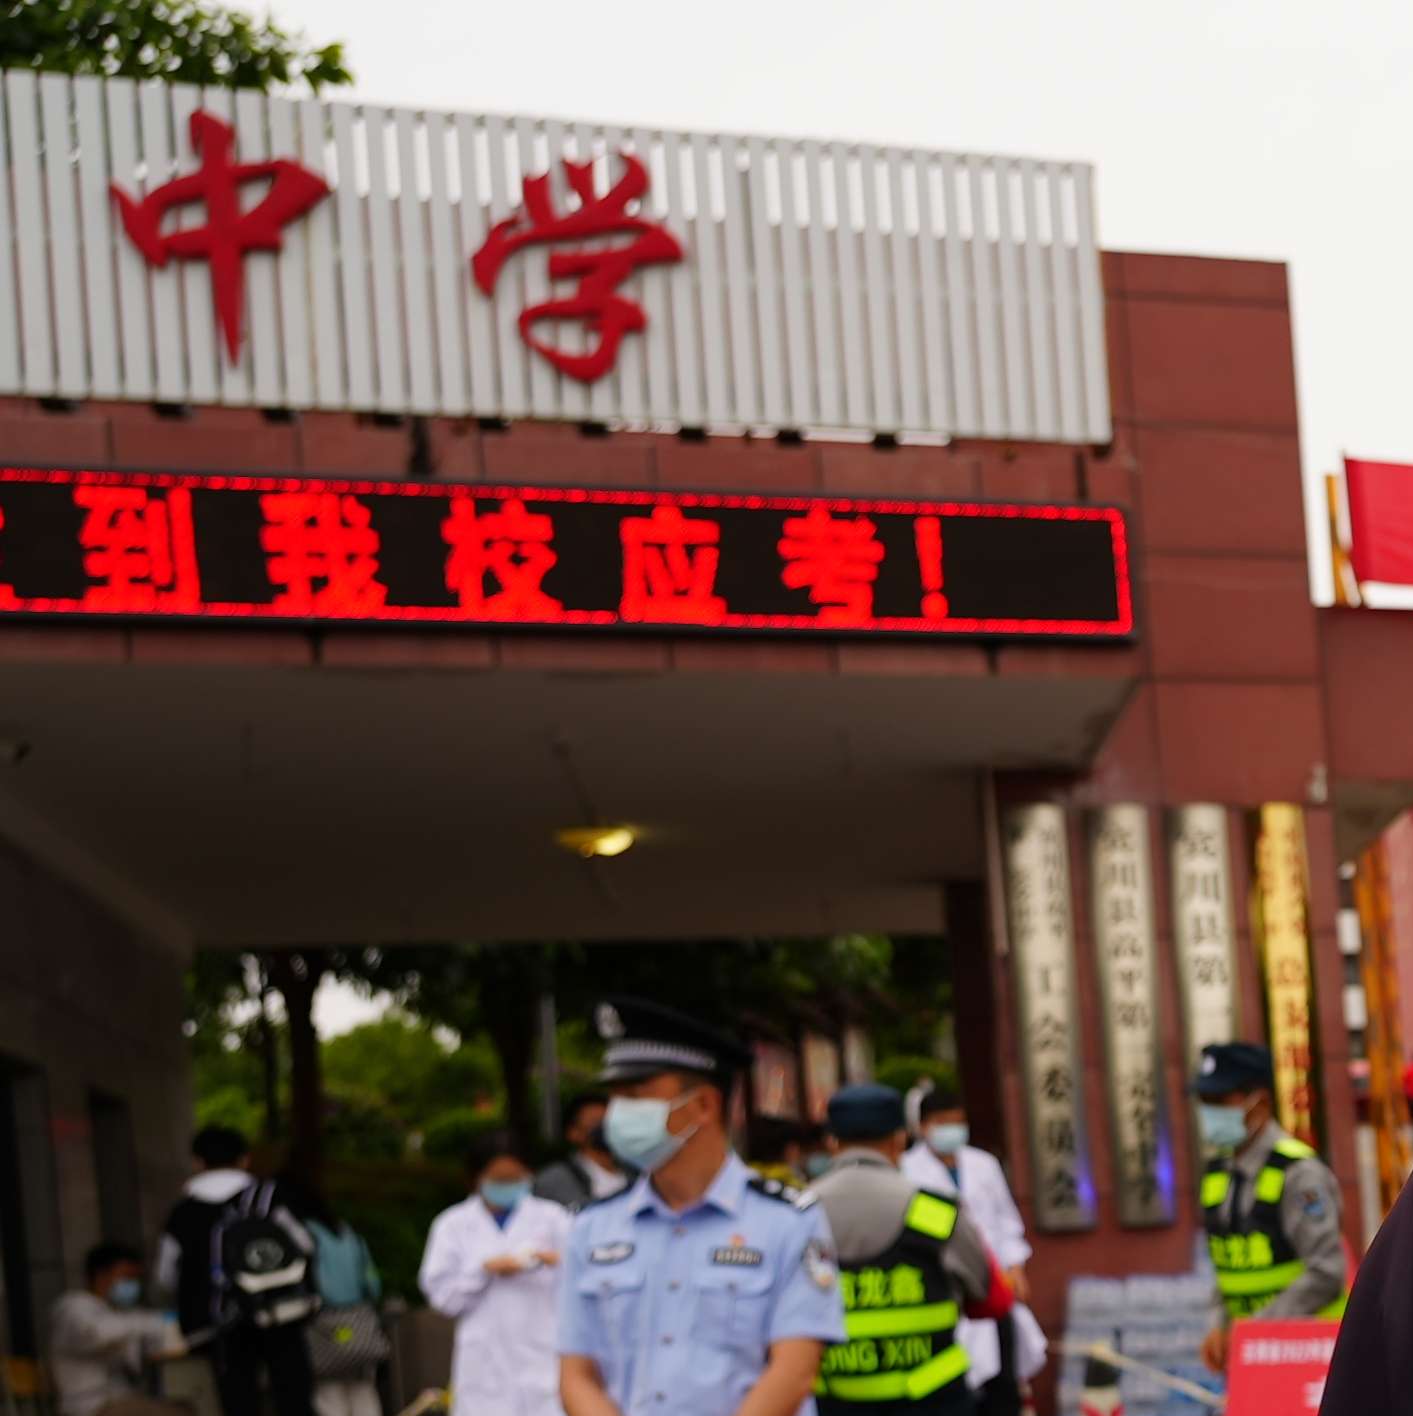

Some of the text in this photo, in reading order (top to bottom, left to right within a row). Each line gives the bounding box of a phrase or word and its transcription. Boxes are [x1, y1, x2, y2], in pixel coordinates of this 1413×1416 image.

[110, 108, 684, 381] 中学
[0, 484, 950, 627] 到我校应考!
